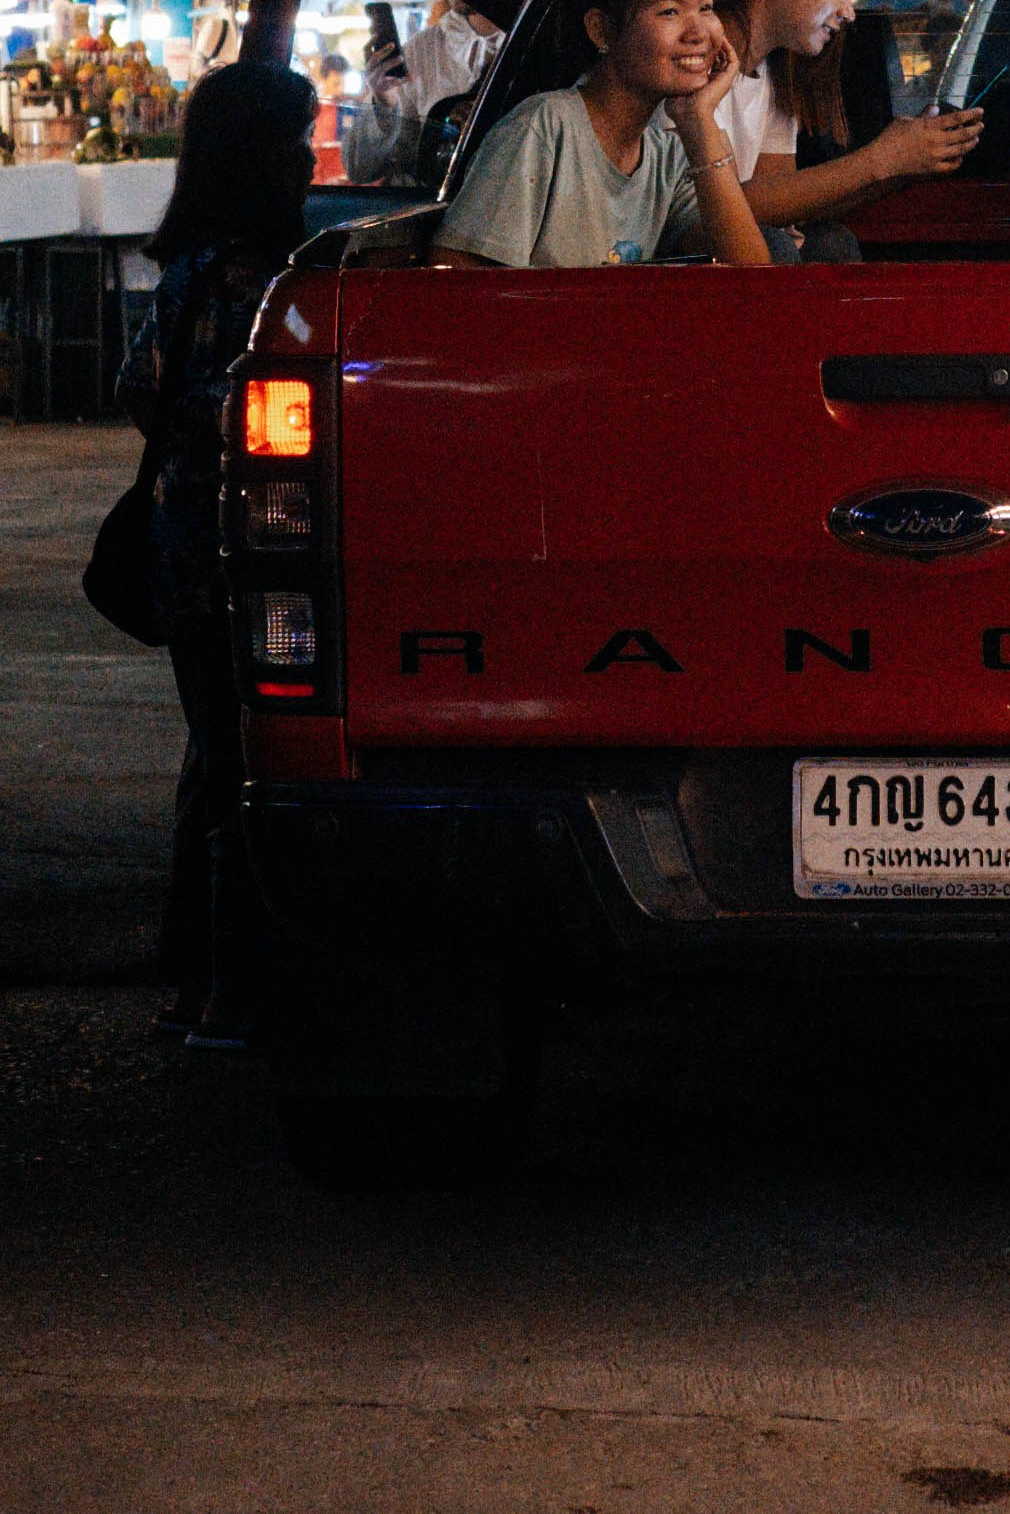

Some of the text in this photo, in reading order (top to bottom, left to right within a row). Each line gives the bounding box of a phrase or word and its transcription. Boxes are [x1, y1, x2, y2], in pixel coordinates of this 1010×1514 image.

[885, 504, 964, 534] Ford
[813, 775, 925, 832] 4กญ
[853, 884, 888, 897] Auto
[892, 883, 942, 898] Gallery
